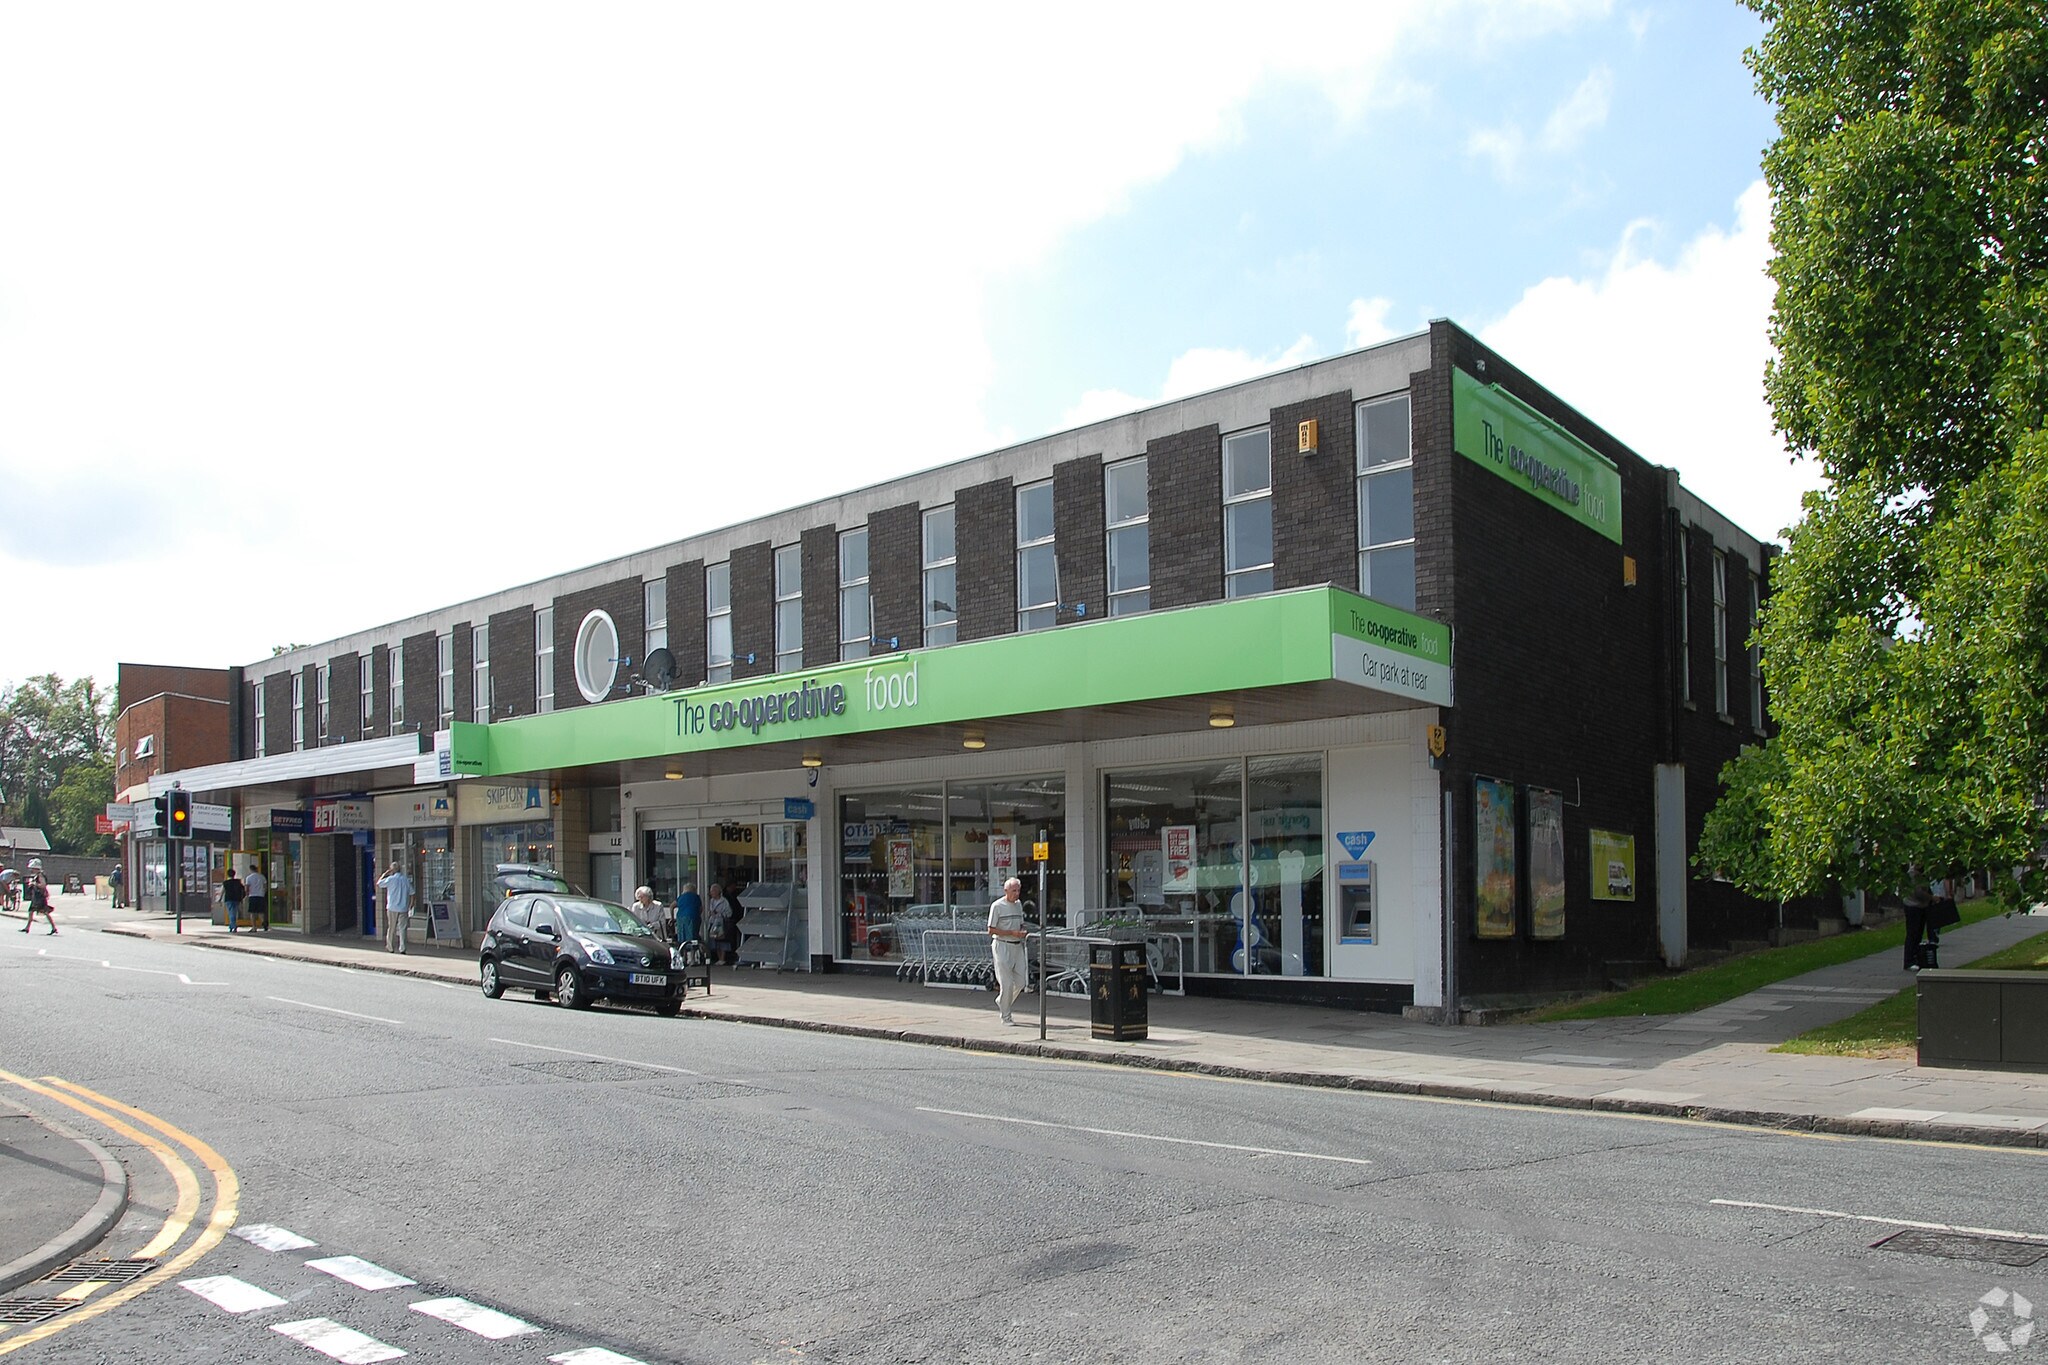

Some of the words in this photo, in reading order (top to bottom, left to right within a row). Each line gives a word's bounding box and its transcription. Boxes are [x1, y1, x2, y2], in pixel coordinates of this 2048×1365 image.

[1482, 419, 1504, 465] The
[1583, 483, 1605, 522] food
[1350, 609, 1366, 634] The
[1421, 632, 1438, 656] food
[1362, 652, 1378, 677] Car
[1380, 661, 1400, 684] park
[1401, 665, 1410, 687] at
[1411, 671, 1428, 690] rear
[673, 698, 704, 736] The
[864, 660, 919, 712] food
[486, 785, 524, 805] SKIPTON
[720, 825, 752, 842] Here
[1345, 834, 1368, 846] cash
[1170, 845, 1188, 856] FREE
